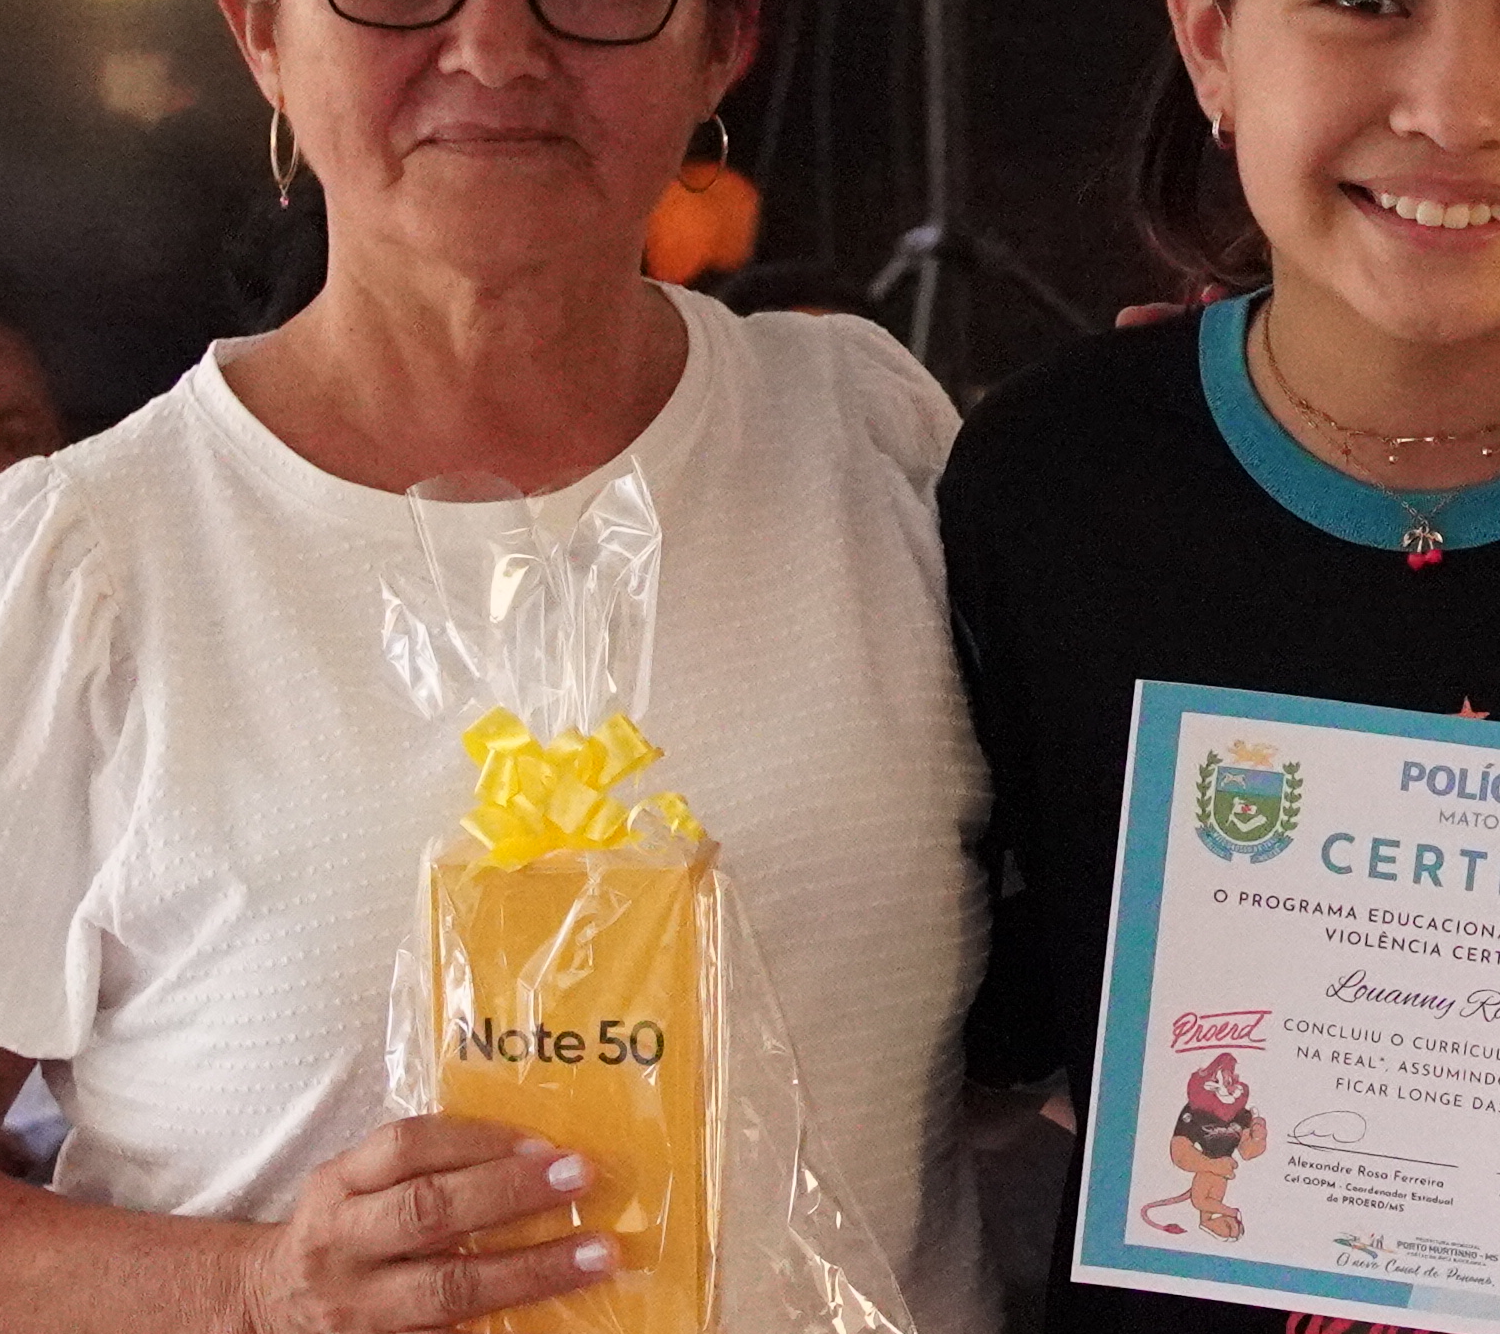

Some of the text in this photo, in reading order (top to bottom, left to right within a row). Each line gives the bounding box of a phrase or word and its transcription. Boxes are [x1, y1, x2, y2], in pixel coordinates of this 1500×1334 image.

[1438, 809, 1500, 830] MATO
[1213, 889, 1228, 903] O
[1239, 891, 1358, 920] PROGRAMA
[1325, 927, 1442, 957] VIOLÊNCIA
[1326, 969, 1456, 1019] Louanny
[458, 1017, 664, 1066] Note 50
[1171, 1010, 1272, 1051] Proerd
[1283, 1018, 1381, 1044] CONCLUIU
[1390, 1033, 1404, 1047] O
[1296, 1045, 1321, 1062] NA
[1335, 1077, 1388, 1097] FICAR
[1397, 1085, 1463, 1107] LONGE
[1288, 1155, 1445, 1189] Alexandre Rosa Ferreira
[1284, 1173, 1300, 1184] Cel
[1303, 1176, 1336, 1189] QOPM
[1345, 1182, 1408, 1200] Coordenador
[1411, 1192, 1454, 1206] Estadual
[1342, 1195, 1405, 1213] PROERD/MS
